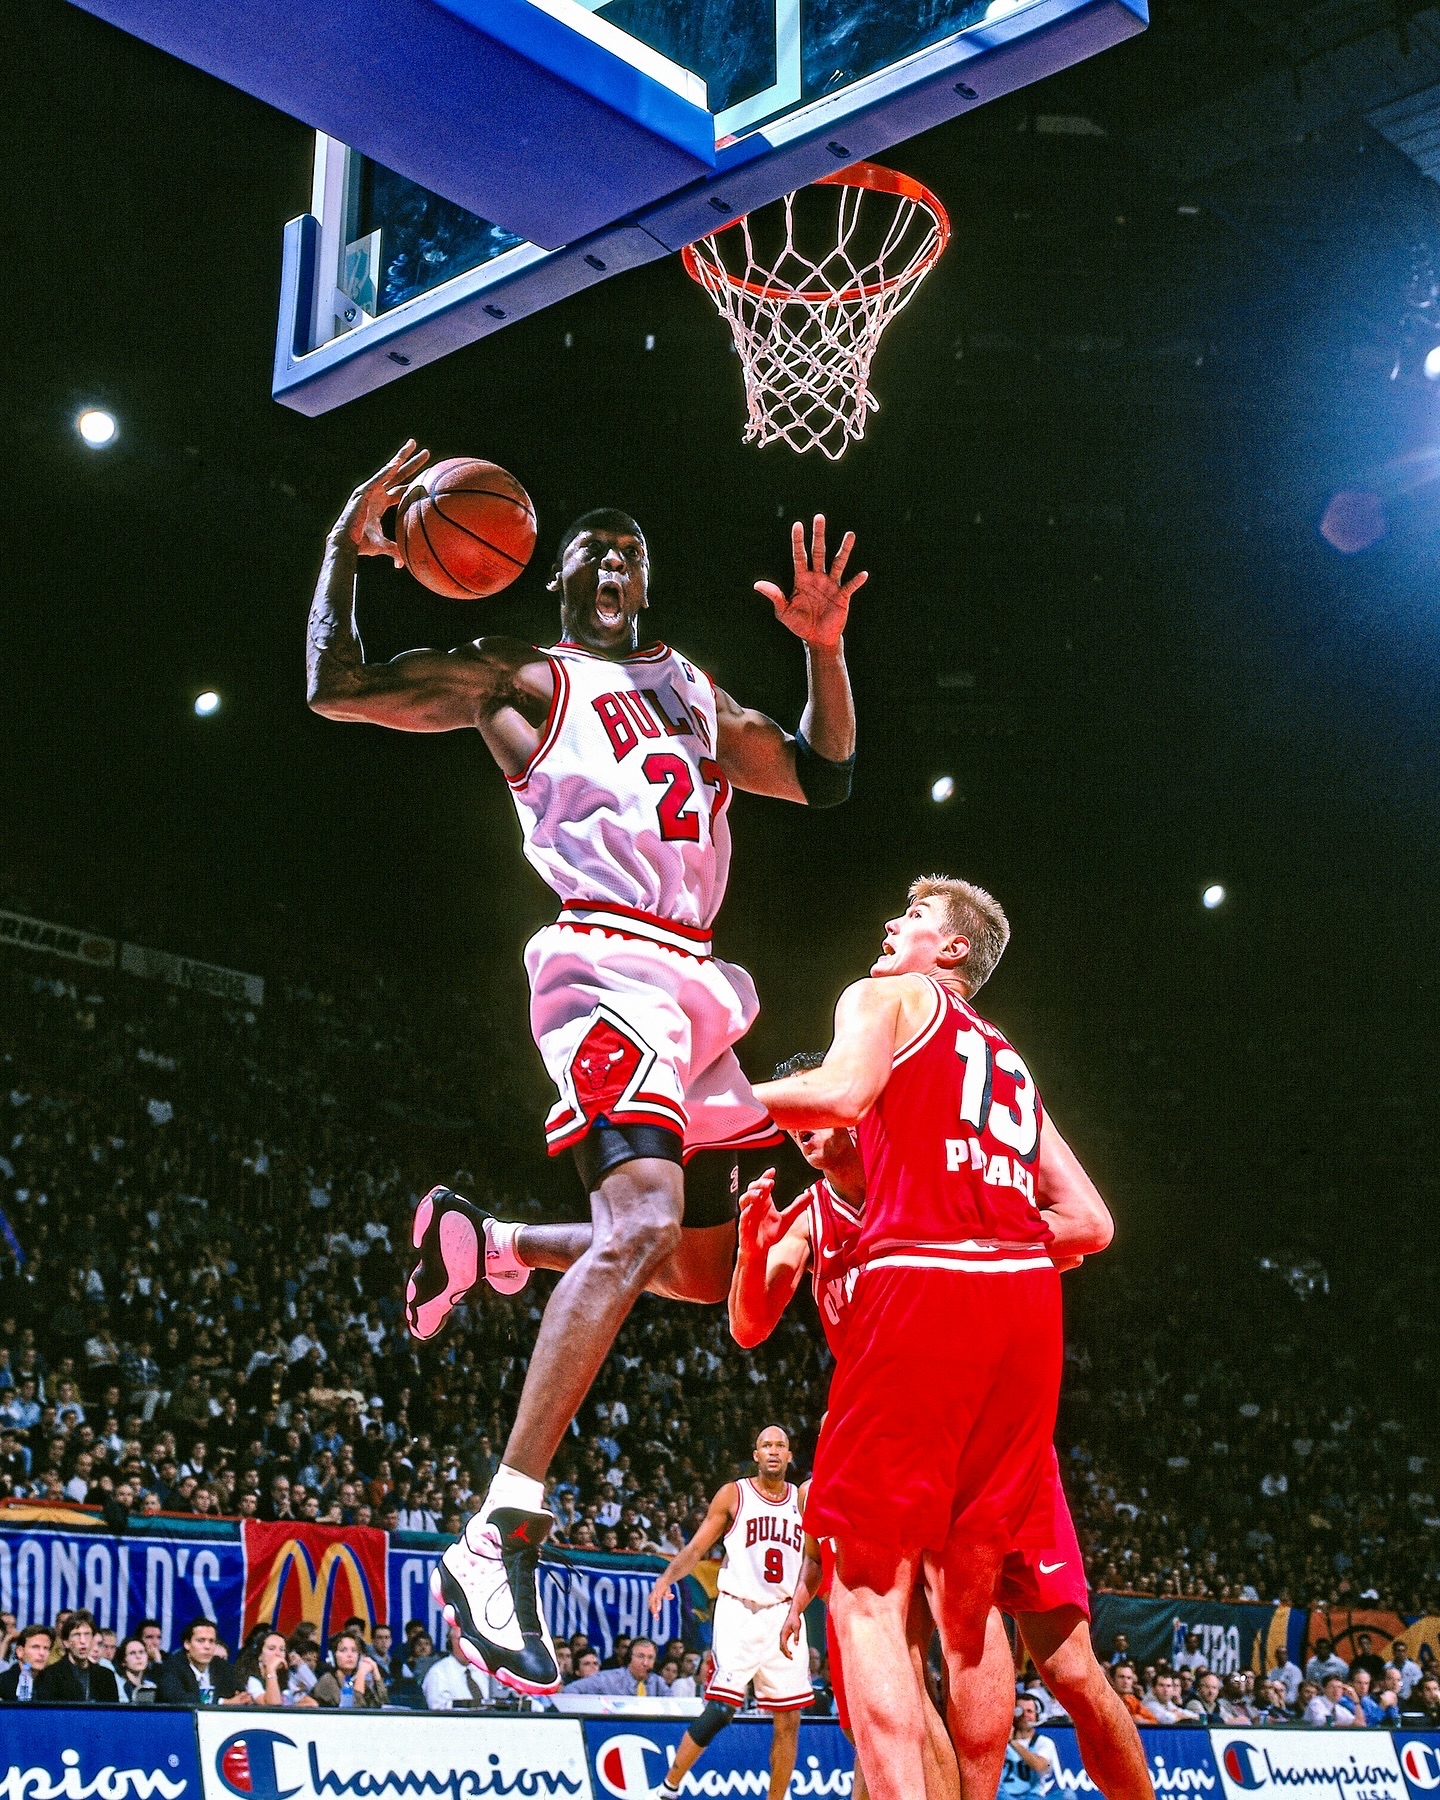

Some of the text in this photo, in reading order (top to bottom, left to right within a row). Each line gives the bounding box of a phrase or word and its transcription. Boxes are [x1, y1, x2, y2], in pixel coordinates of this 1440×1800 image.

[953, 1026, 1041, 1162] 13
[745, 1515, 803, 1553] BULLS
[763, 1547, 784, 1584] 9
[0, 1749, 187, 1800] pion
[215, 1728, 583, 1800] Champion
[1223, 1740, 1398, 1800] Champion
